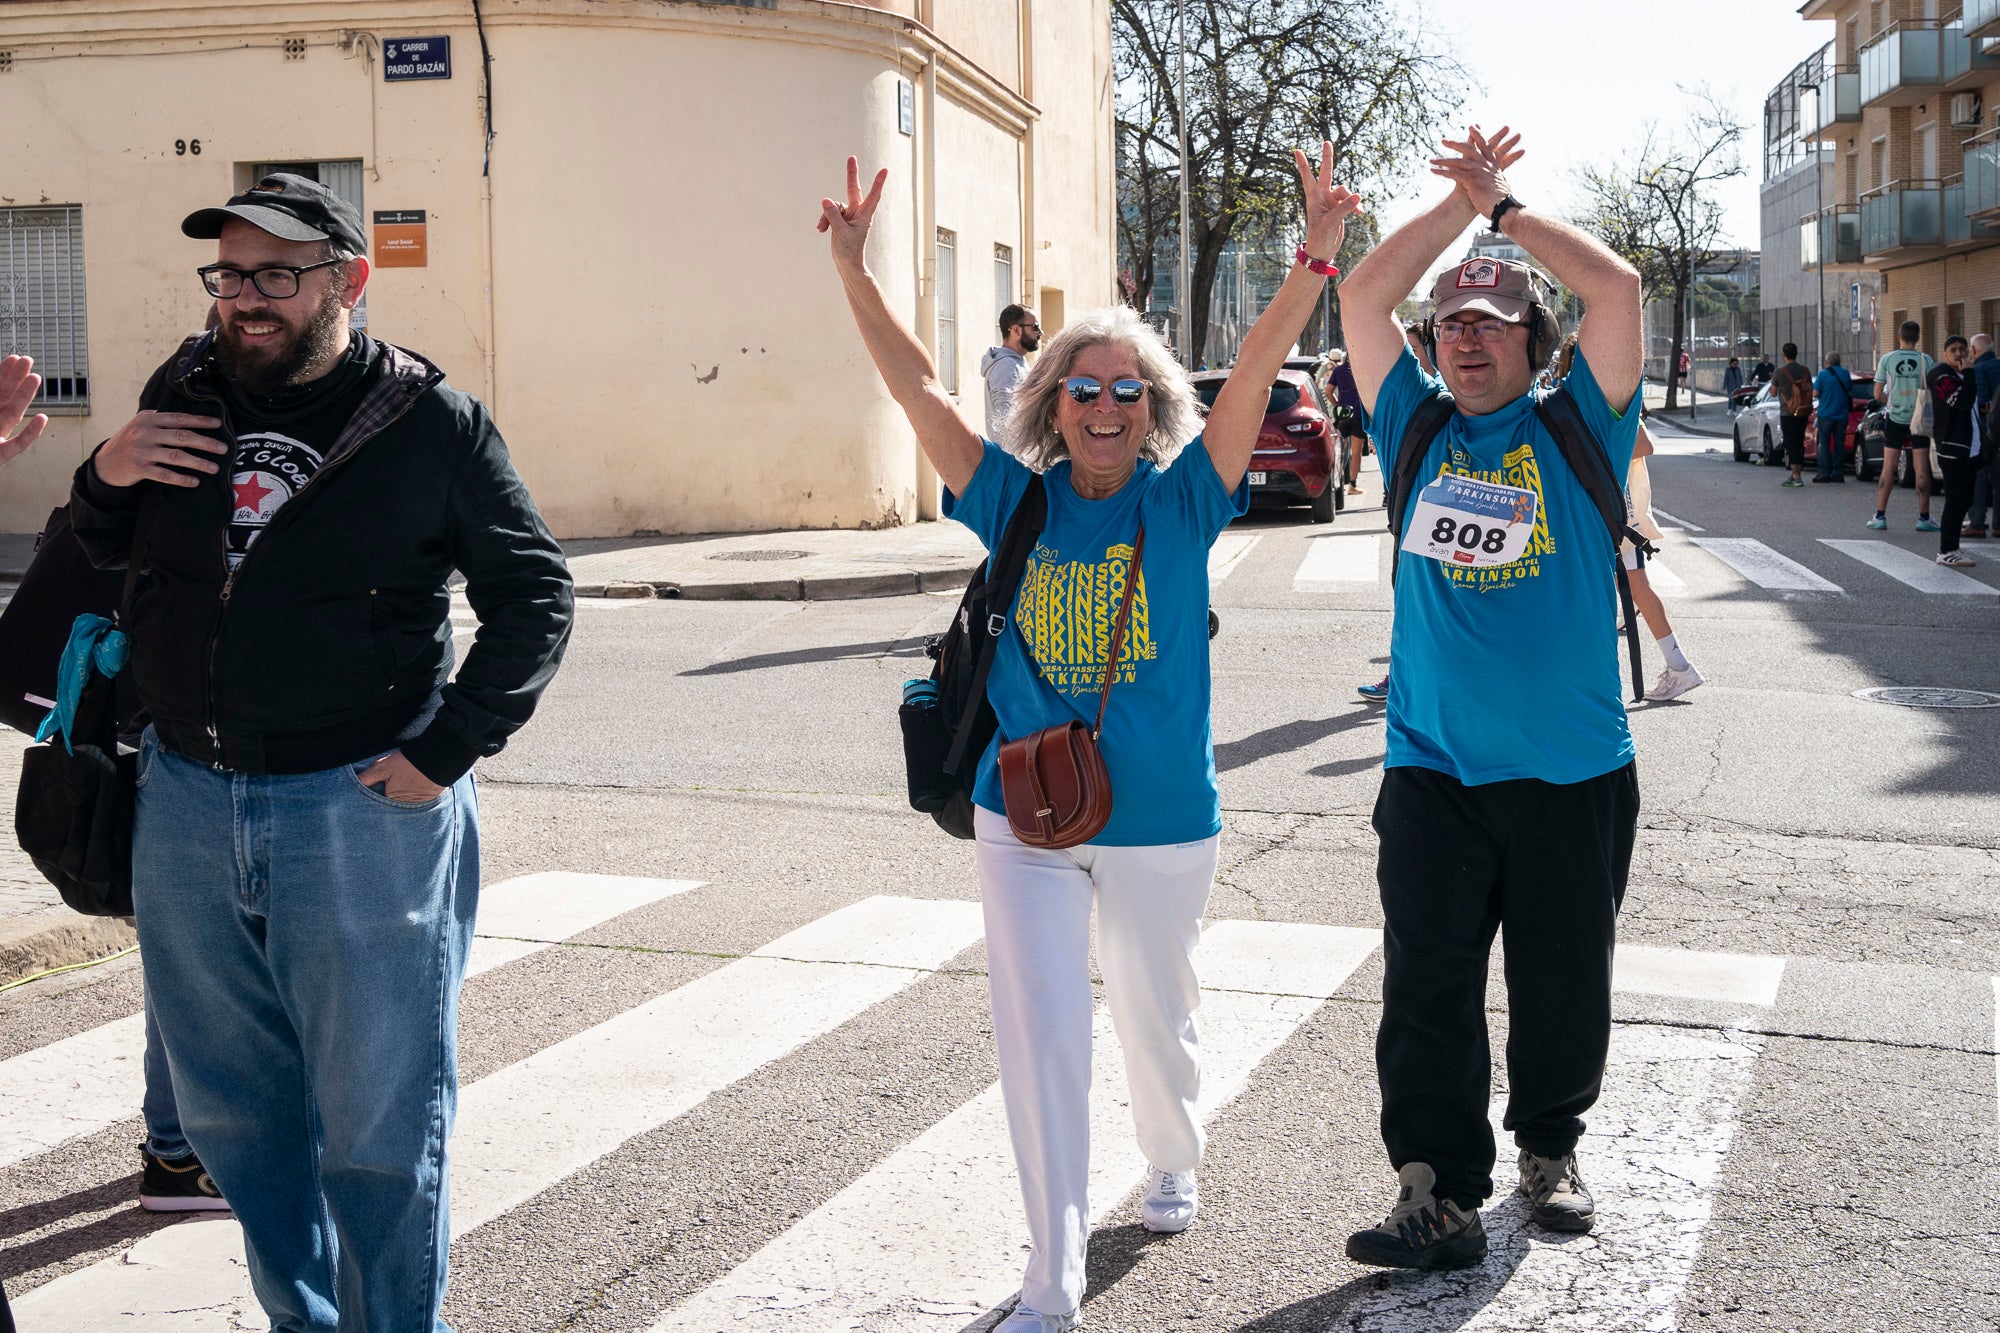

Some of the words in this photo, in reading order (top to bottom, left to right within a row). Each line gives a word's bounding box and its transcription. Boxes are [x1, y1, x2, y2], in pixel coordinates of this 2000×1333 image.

[402, 43, 429, 52] CARRER
[387, 64, 415, 75] PARDO
[416, 61, 445, 73] BAZÁN
[175, 138, 201, 156] 96
[1249, 473, 1263, 483] ST
[1448, 485, 1517, 506] PARKINSON
[1431, 517, 1507, 554] 808
[1525, 558, 1539, 566] PEL
[1442, 565, 1540, 583] ARKINSON
[1121, 663, 1136, 671] PEL
[1045, 671, 1137, 686] RKINSON
